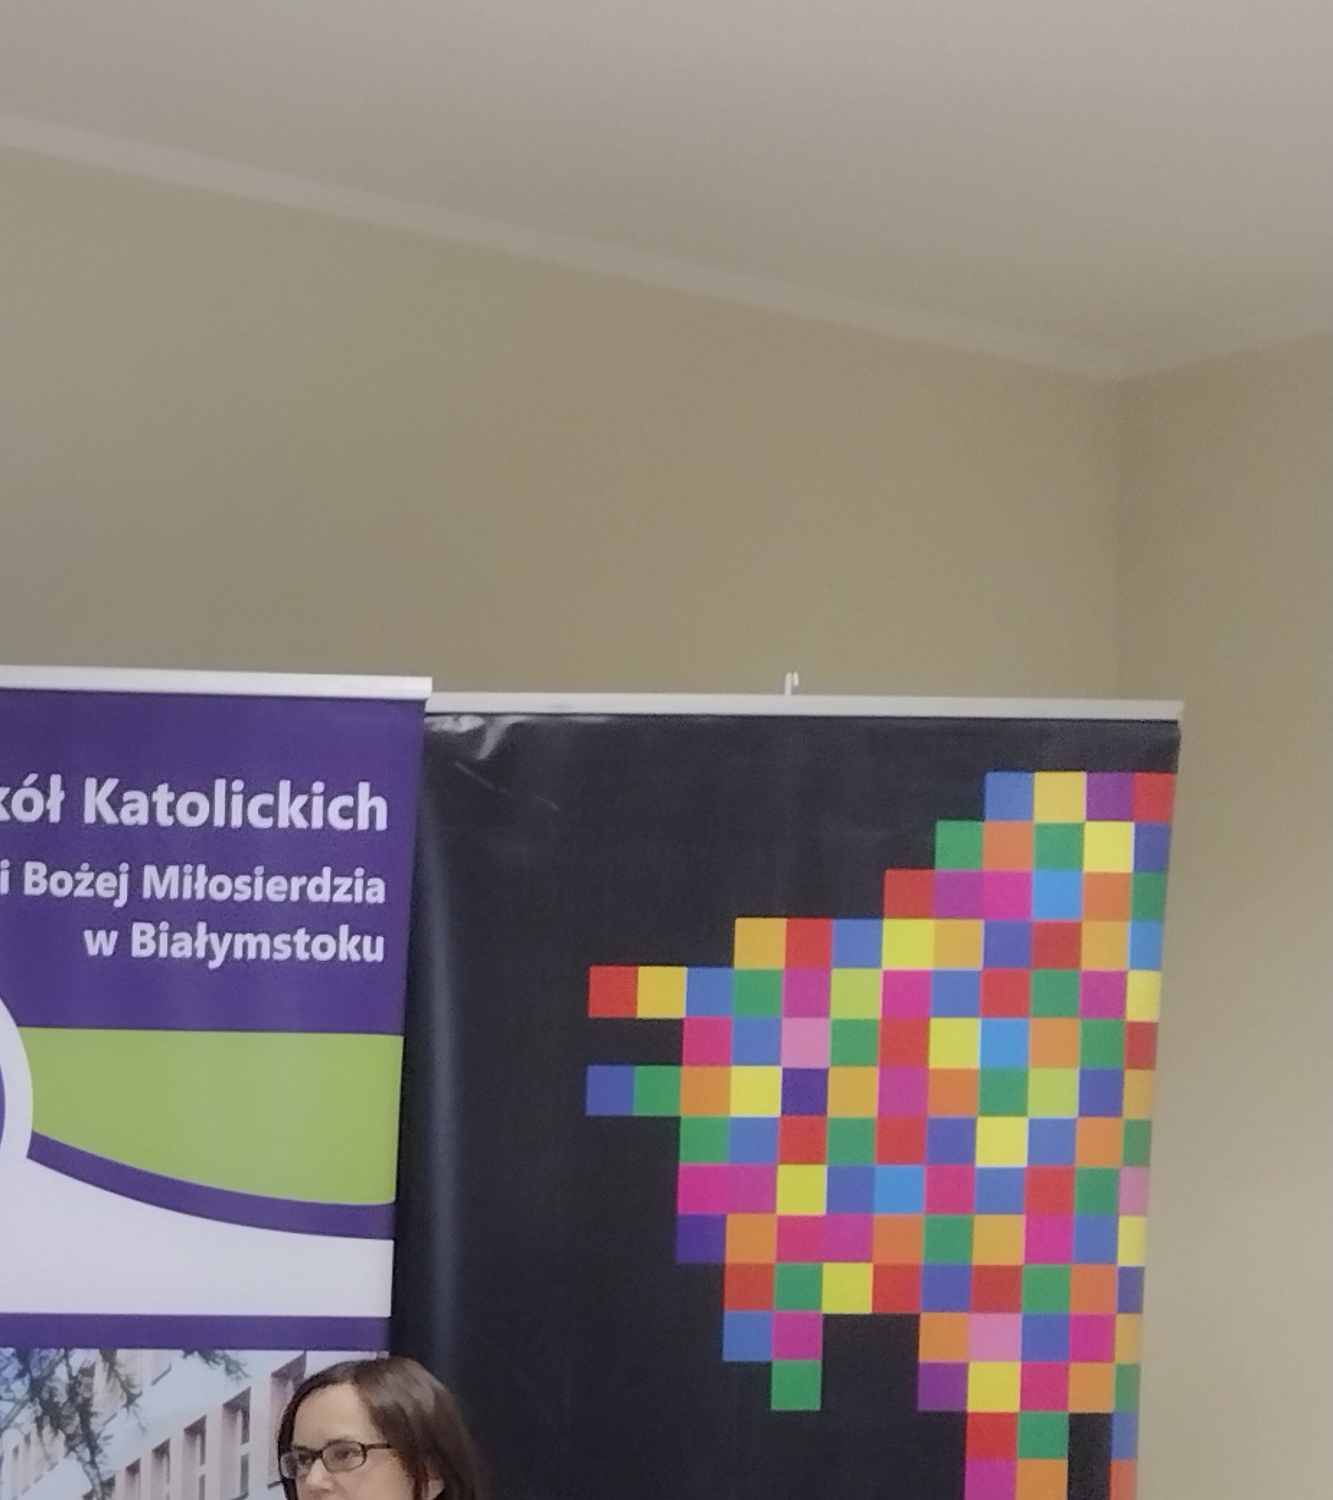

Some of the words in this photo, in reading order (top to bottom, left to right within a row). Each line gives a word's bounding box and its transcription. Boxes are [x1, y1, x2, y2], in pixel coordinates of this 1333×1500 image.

[84, 777, 389, 832] Katolickich
[23, 860, 130, 908] Bożej
[142, 864, 386, 905] Miłosierdzia
[84, 929, 117, 957] w
[131, 923, 385, 969] Białymstoku
